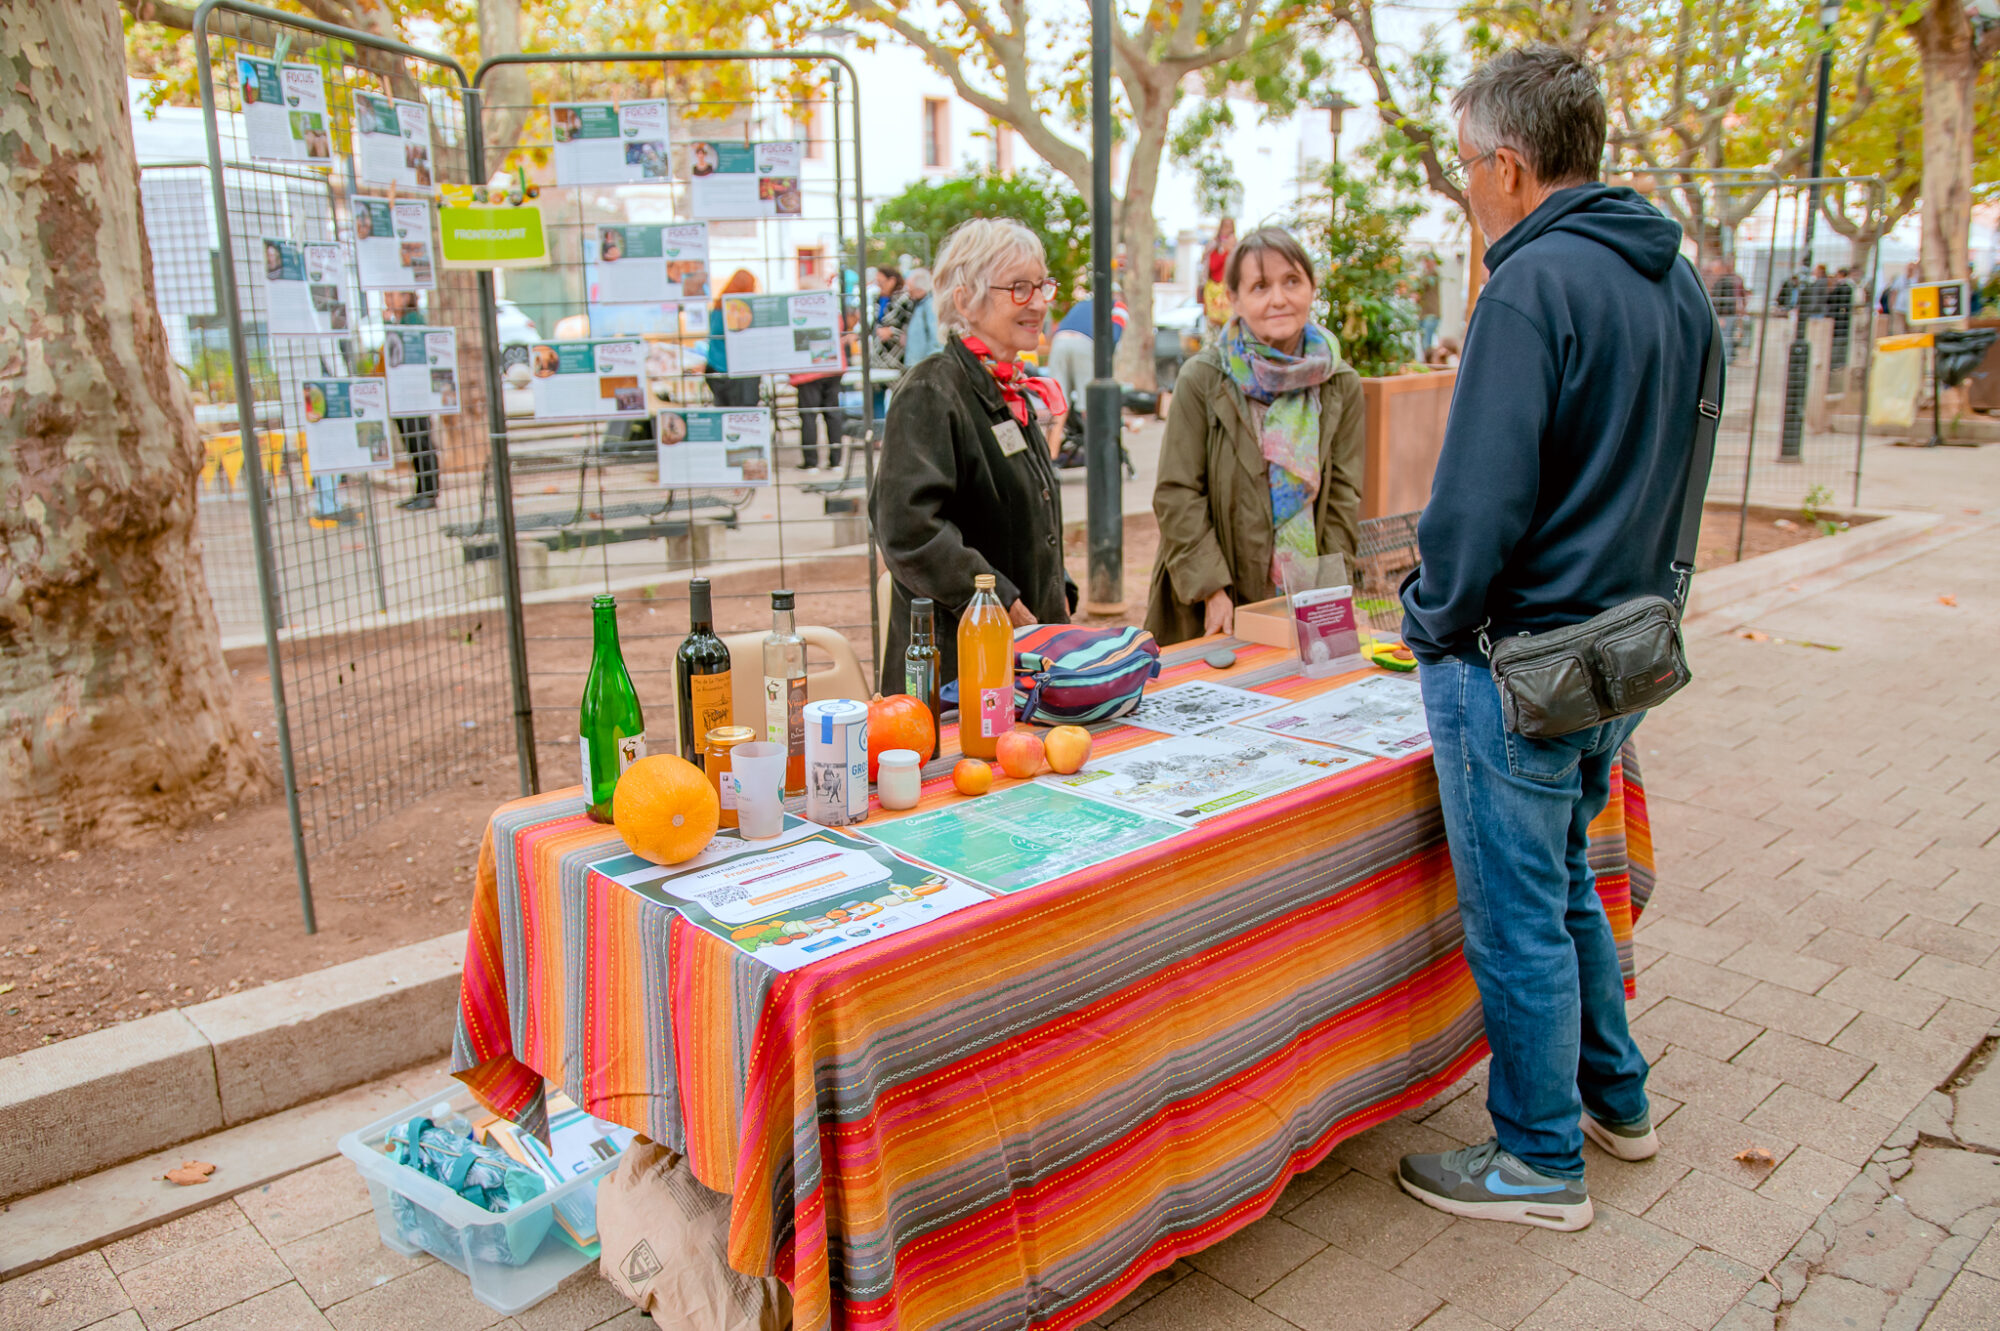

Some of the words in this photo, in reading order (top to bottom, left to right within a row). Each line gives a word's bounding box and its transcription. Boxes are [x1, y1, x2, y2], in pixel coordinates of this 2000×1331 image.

[625, 105, 657, 117] FOCUS
[761, 143, 793, 153] FOCUS
[669, 227, 699, 237] FOCUS
[794, 295, 826, 306] FOCUS
[601, 343, 632, 354] FOCUS
[728, 413, 760, 423] FOCUS
[851, 762, 867, 776] GRO
[722, 860, 780, 879] Frontignan
